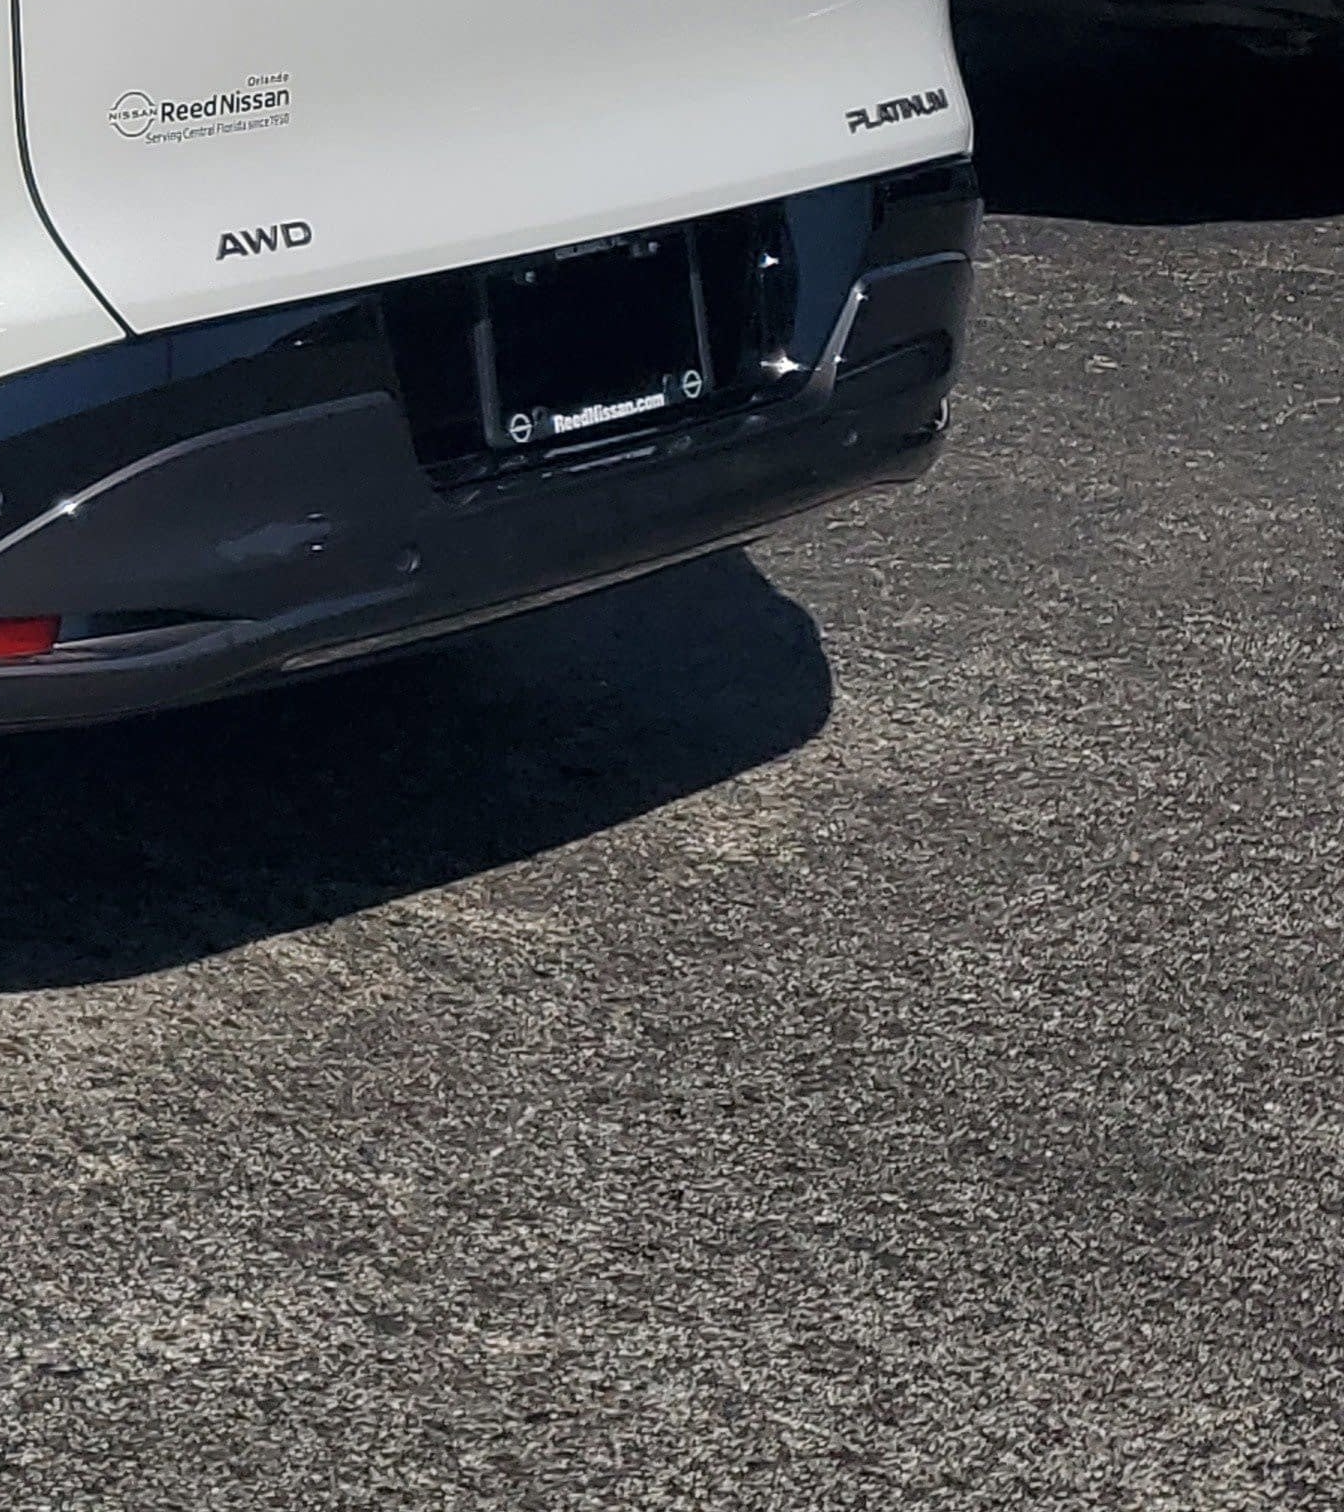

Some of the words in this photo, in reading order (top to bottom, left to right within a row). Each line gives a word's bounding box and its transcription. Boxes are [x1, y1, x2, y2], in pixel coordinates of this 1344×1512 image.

[247, 73, 289, 87] Orlando
[109, 108, 158, 121] NISSAN
[161, 95, 217, 123] Reed
[220, 88, 290, 115] Nissan
[845, 88, 949, 134] PLATINUM
[145, 130, 183, 145] Serving
[215, 221, 312, 260] AWD
[552, 393, 666, 434] ReedNissan.com
